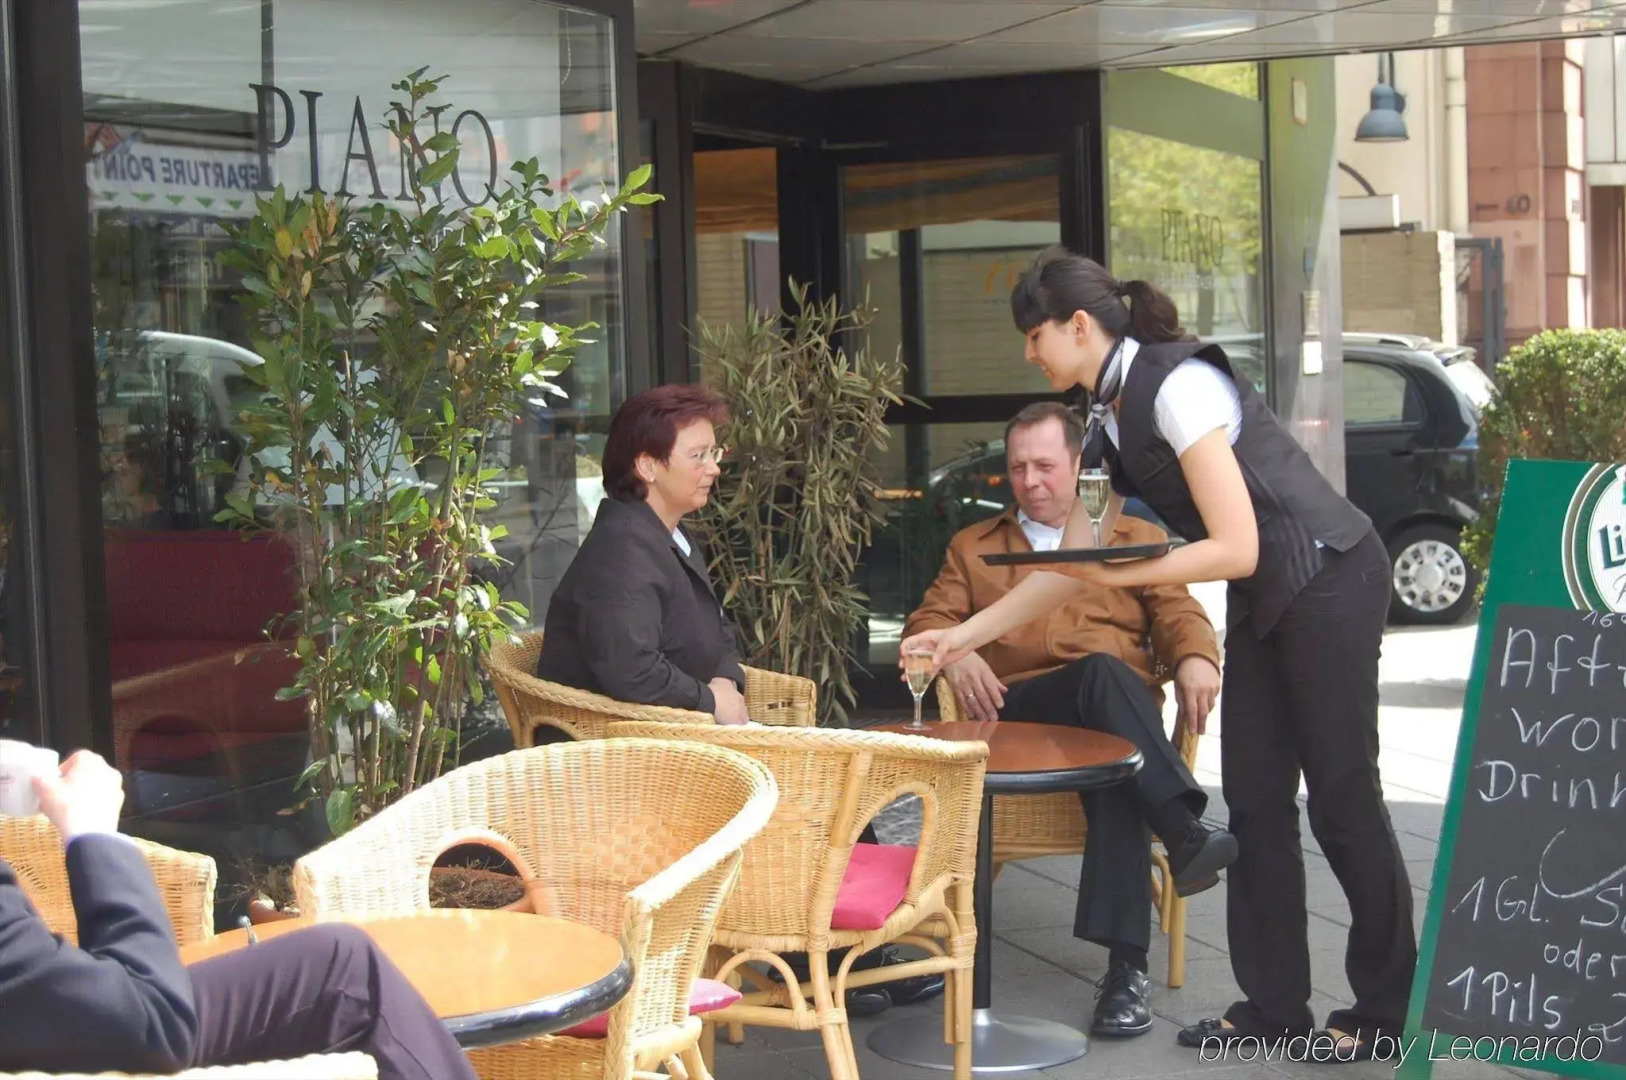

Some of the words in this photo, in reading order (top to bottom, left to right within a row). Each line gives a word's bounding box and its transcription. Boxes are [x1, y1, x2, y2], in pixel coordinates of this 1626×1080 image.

[248, 83, 498, 207] PIANO
[1580, 882, 1626, 935] S
[1543, 938, 1626, 980] oder
